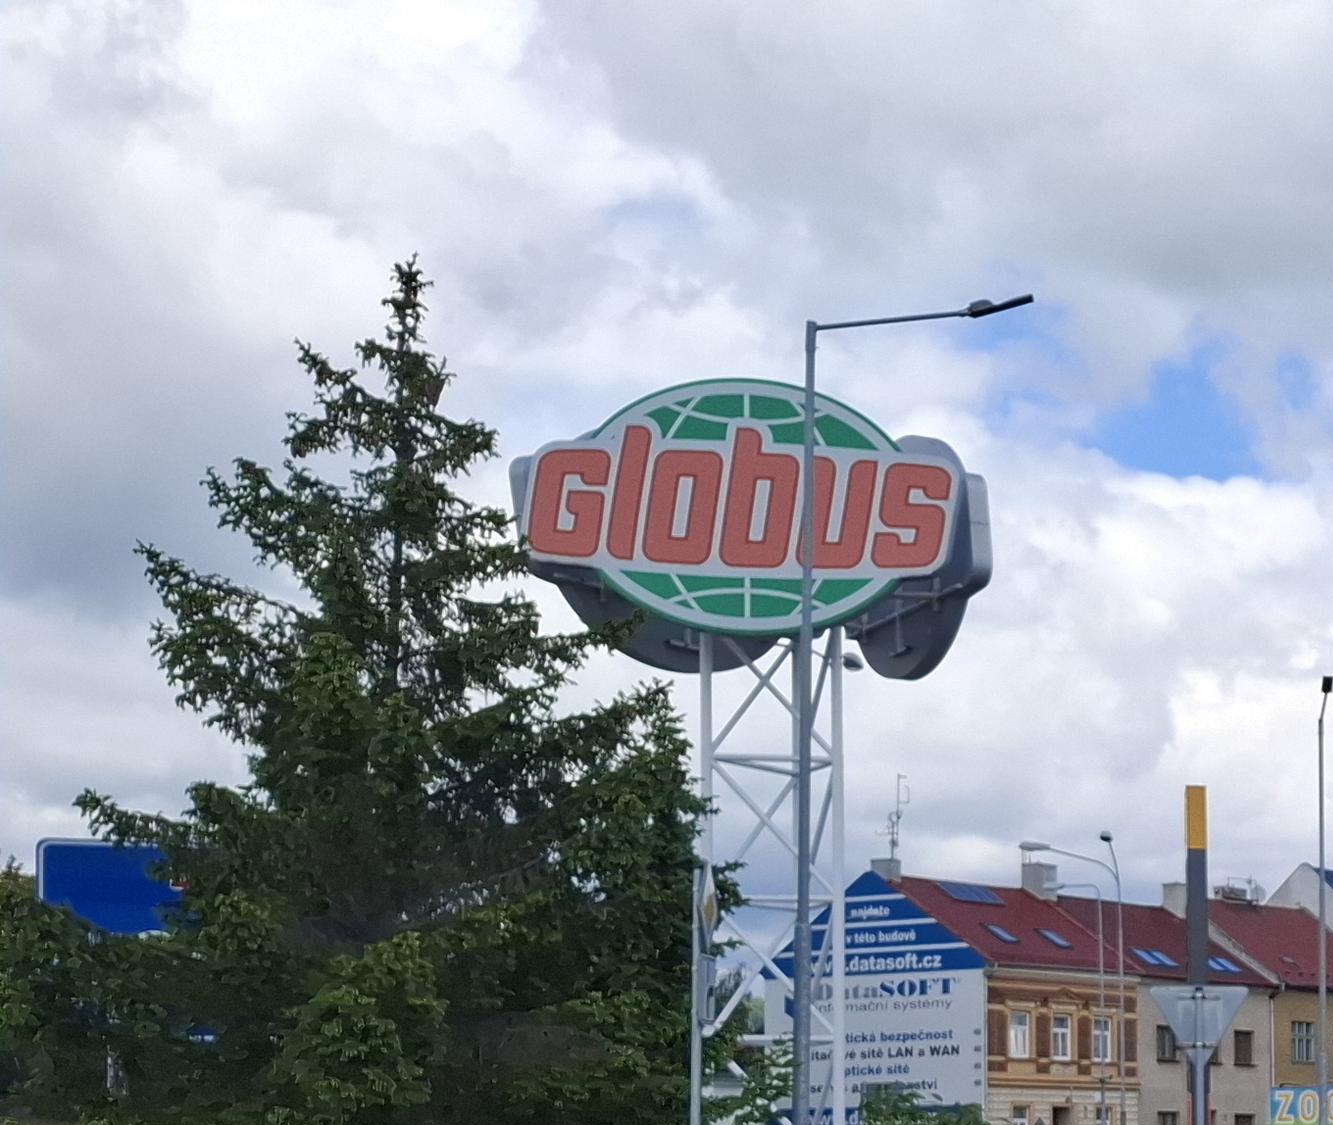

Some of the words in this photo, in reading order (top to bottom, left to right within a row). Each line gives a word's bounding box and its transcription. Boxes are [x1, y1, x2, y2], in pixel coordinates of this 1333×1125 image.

[527, 425, 952, 568] Globus
[853, 930, 876, 944] této
[808, 953, 942, 973] .datasoft.cz
[893, 998, 953, 1012] systémy
[879, 1028, 953, 1044] bezpečnost
[887, 1046, 914, 1059] LAN
[918, 1049, 925, 1058] a
[928, 1044, 961, 1057] WAN
[844, 1065, 882, 1078] ptické
